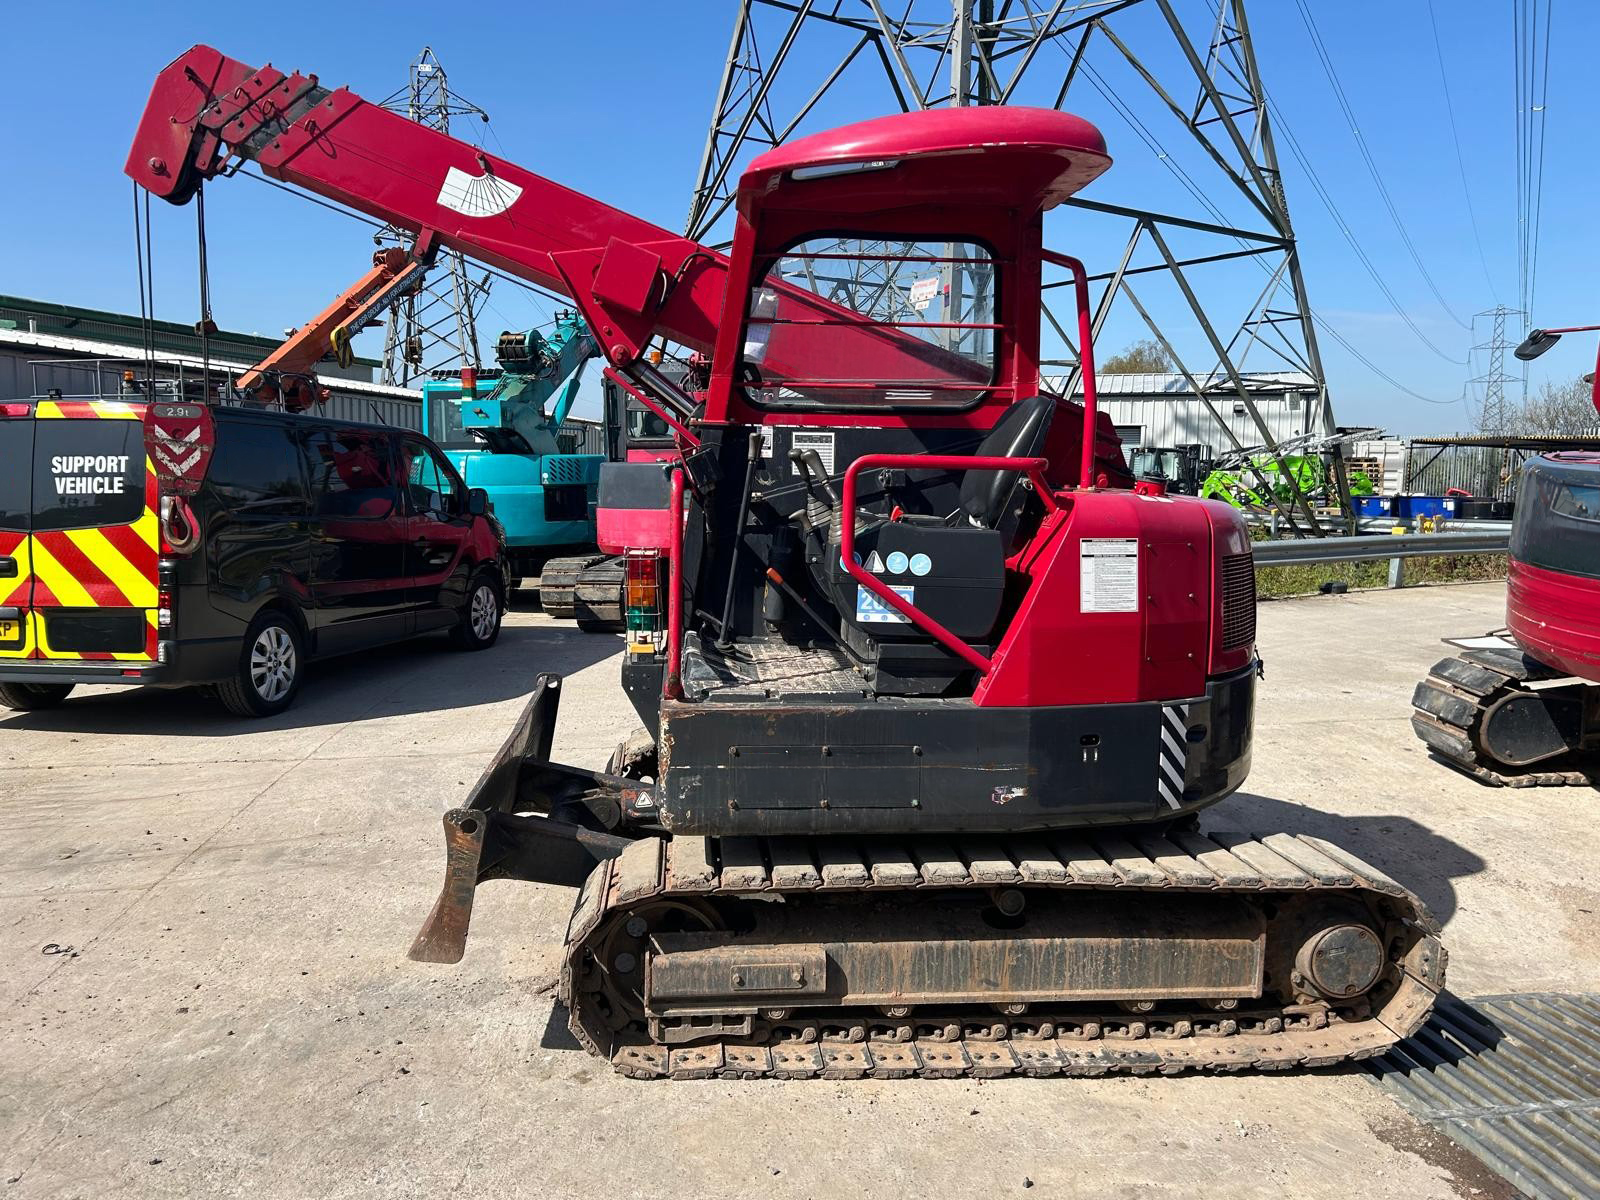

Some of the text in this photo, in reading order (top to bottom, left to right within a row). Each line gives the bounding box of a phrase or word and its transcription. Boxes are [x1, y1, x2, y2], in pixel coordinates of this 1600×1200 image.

[51, 455, 129, 474] SUPPORT
[54, 476, 124, 495] VEHICLE
[0, 622, 11, 637] P
